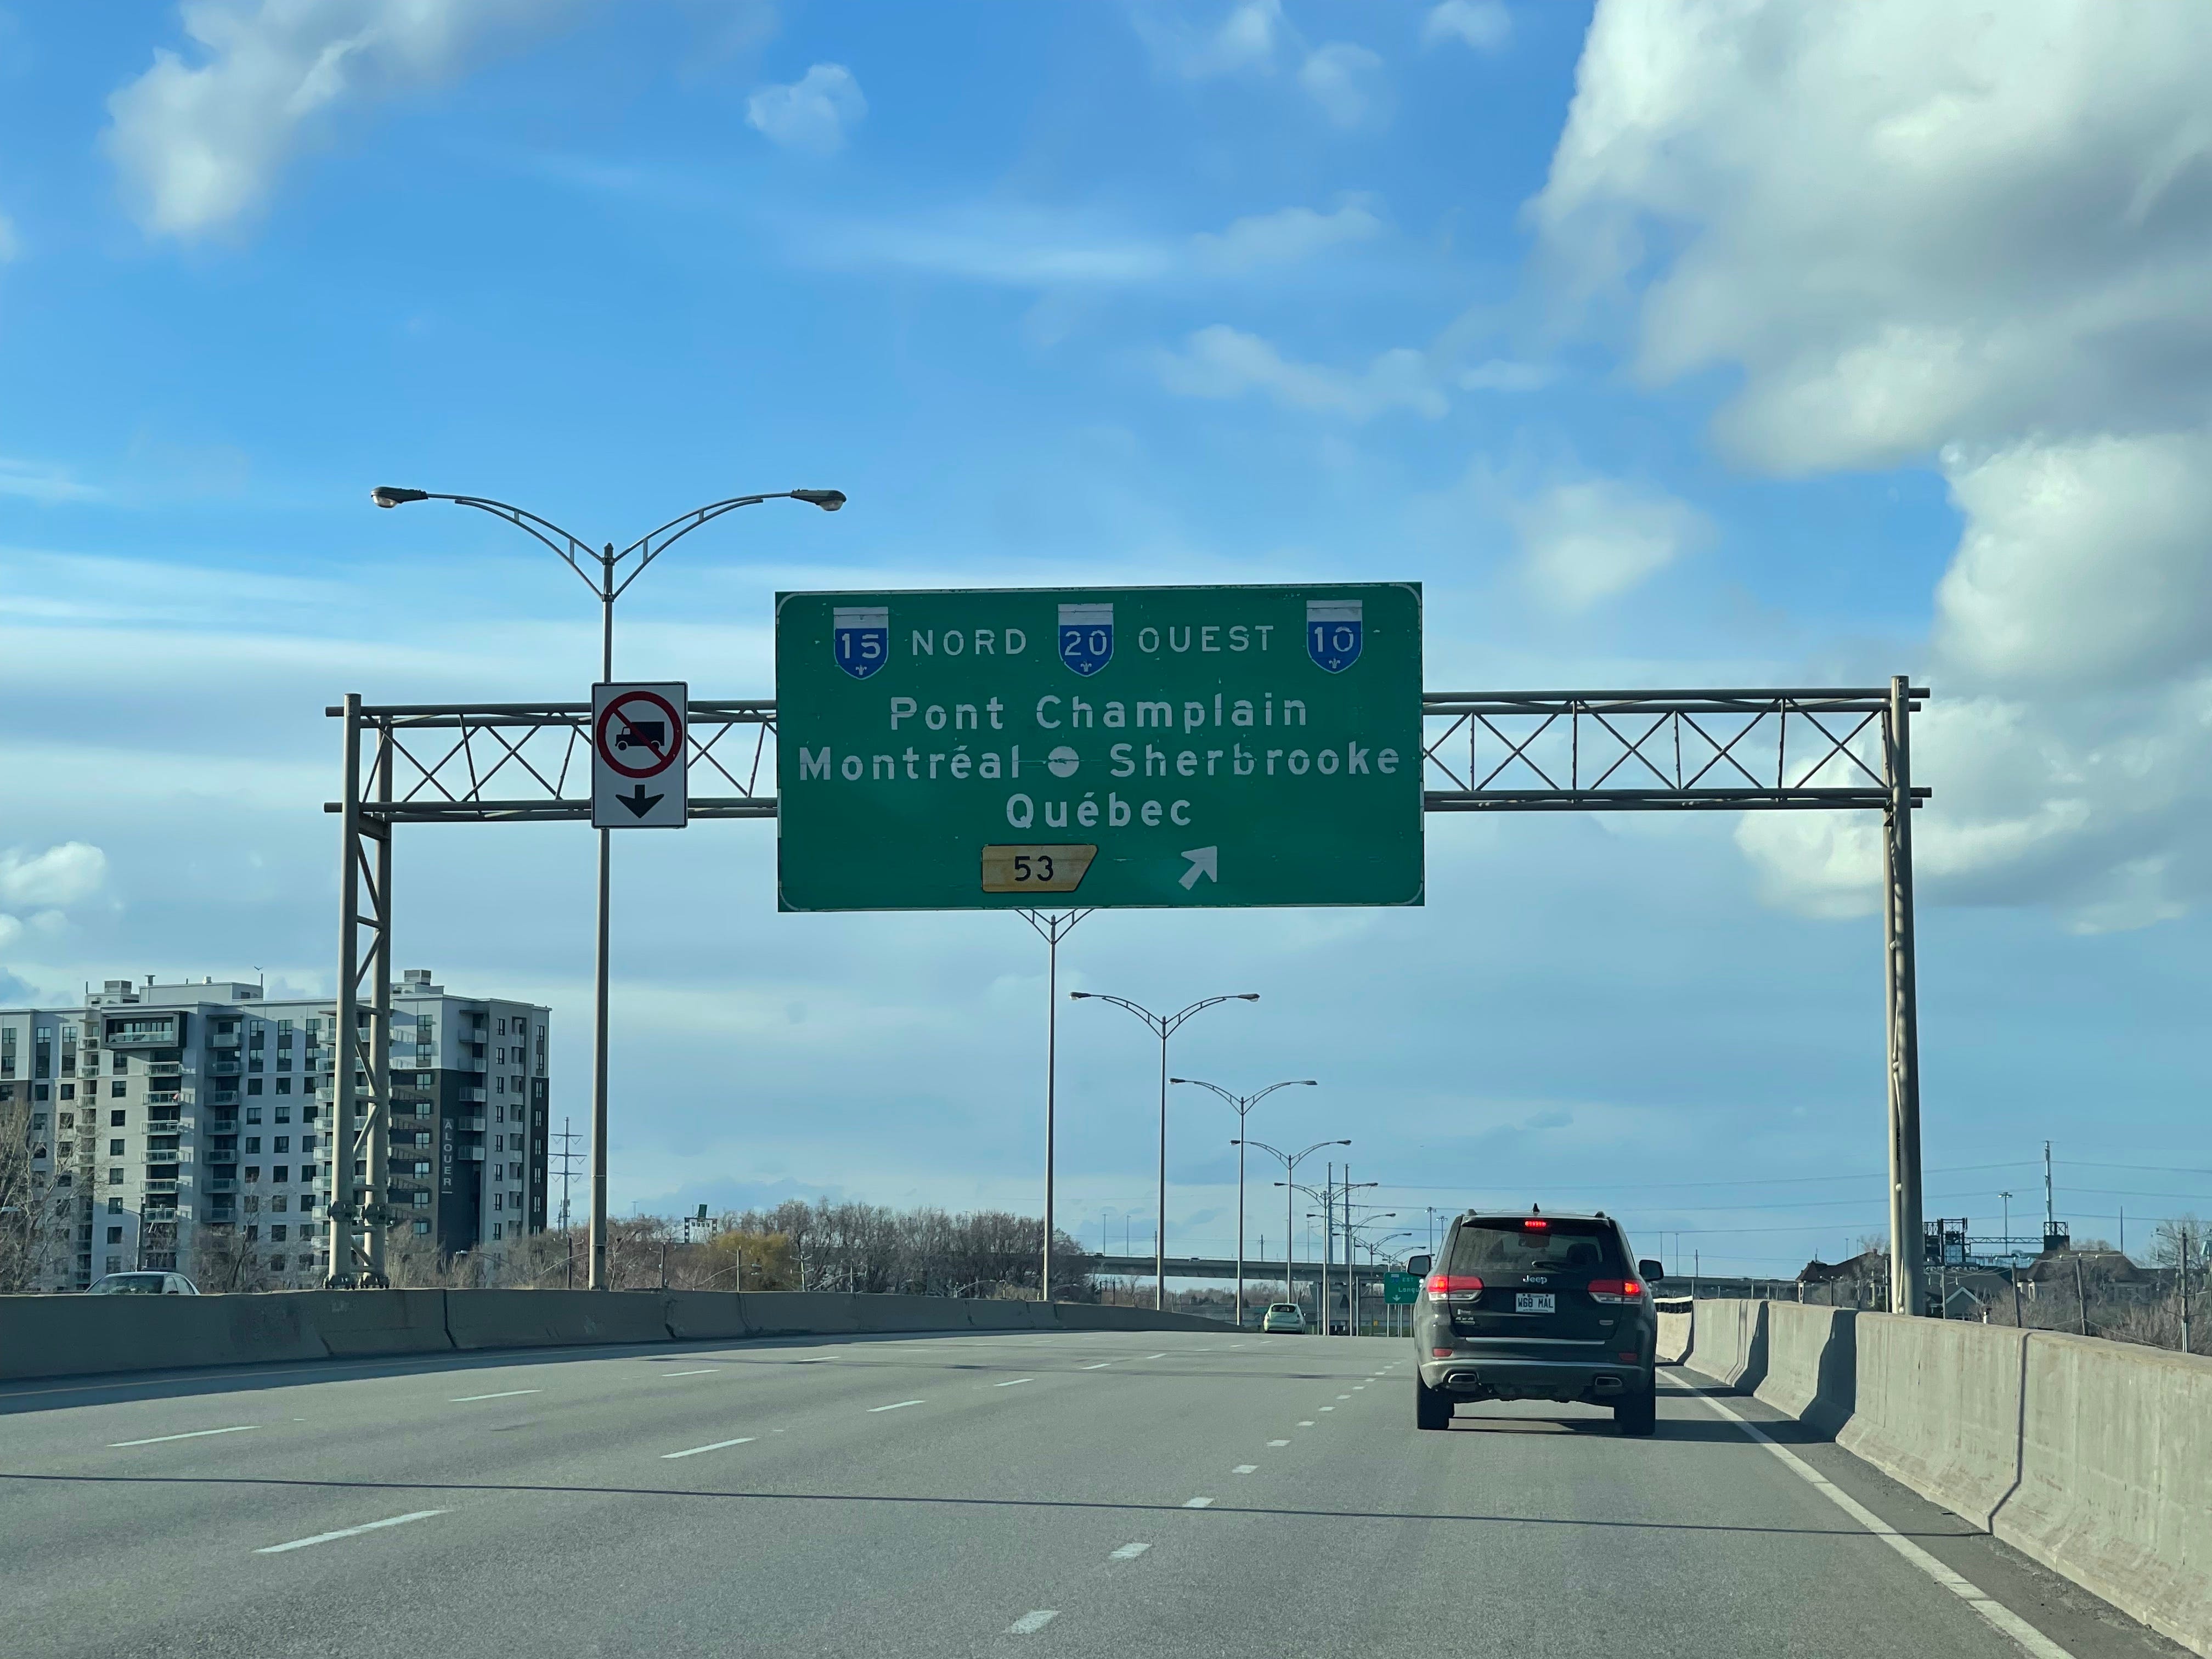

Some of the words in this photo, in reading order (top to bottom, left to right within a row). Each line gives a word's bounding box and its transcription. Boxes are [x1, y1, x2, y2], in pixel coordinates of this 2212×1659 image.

[842, 633, 881, 658] 15
[913, 629, 1026, 656] NORD
[1065, 630, 1107, 656] 20
[1138, 625, 1273, 652] OUEST
[1314, 627, 1354, 652] 10
[891, 696, 1003, 730] Pont
[1036, 692, 1306, 733] Champlain
[799, 744, 1019, 780] Montréal
[1110, 741, 1399, 777] Sherbrooke
[1007, 792, 1190, 829] Québec
[1014, 855, 1054, 882] 53
[1523, 1275, 1547, 1284] Jeep
[1538, 1298, 1554, 1308] MAL
